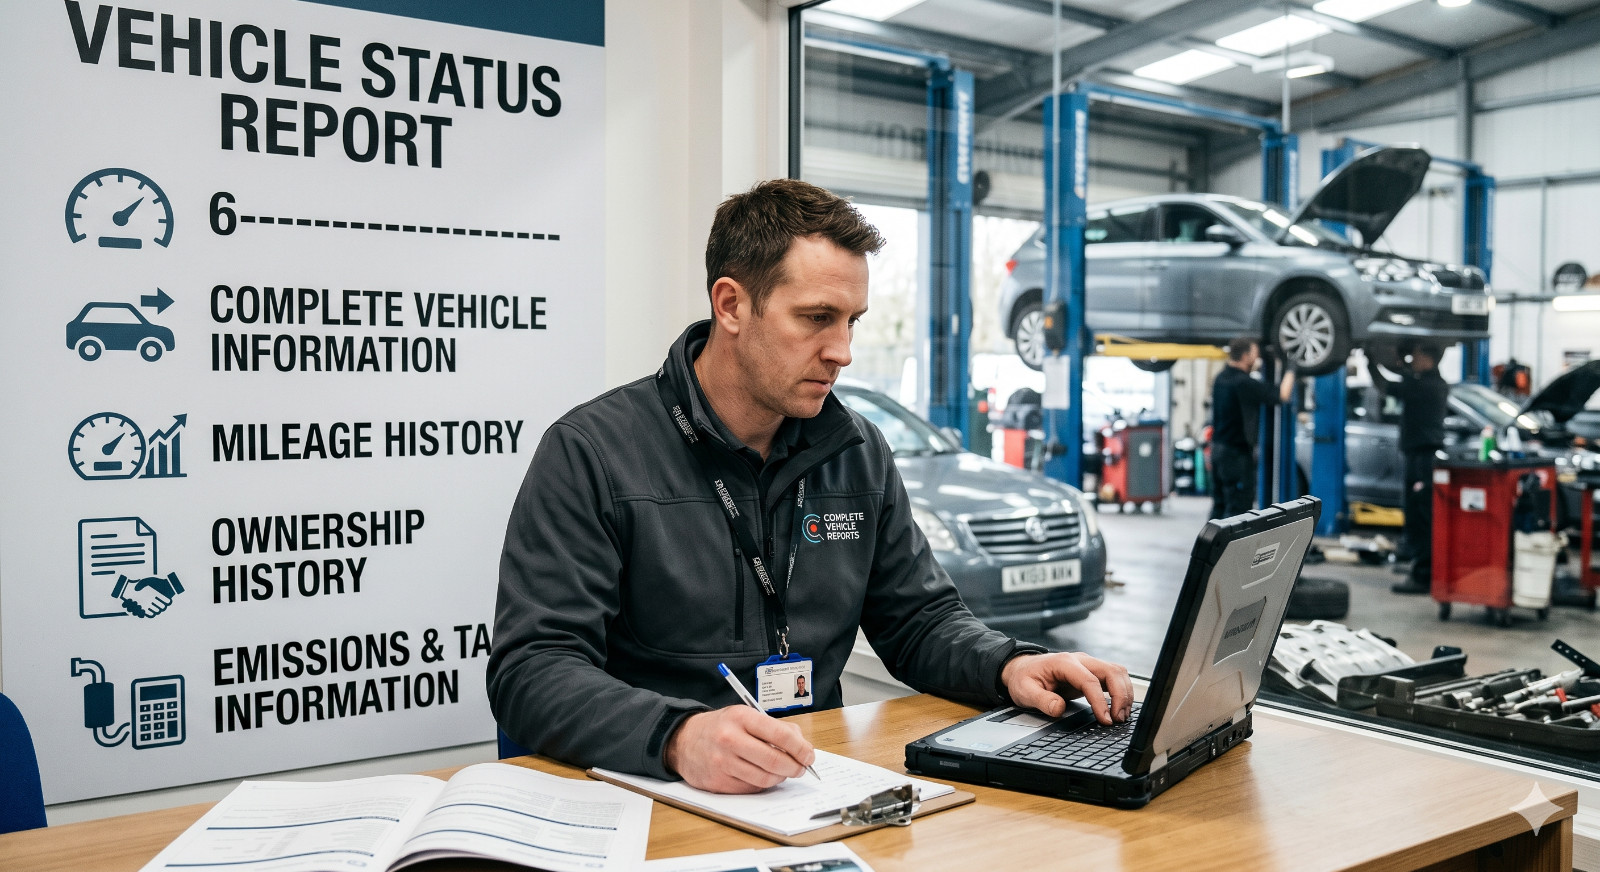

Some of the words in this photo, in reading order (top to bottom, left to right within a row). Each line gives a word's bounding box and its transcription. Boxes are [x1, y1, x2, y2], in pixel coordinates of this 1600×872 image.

[64, 0, 342, 93] VEHICLE
[361, 42, 562, 118] STATUS
[220, 92, 453, 169] REPORT
[210, 284, 404, 327] COMPLETE
[413, 292, 547, 330] VEHICLE
[211, 333, 457, 373] INFORMATION
[212, 421, 373, 462] MILEAGE
[385, 420, 524, 458] HISTORY
[211, 509, 425, 557] OWNERSHIP
[823, 512, 865, 522] COMPLETE
[825, 521, 857, 531] VEHICLE
[826, 531, 860, 541] REPORTS
[212, 556, 368, 605] HISTORY
[213, 630, 410, 687] EMISSIONS
[420, 628, 445, 664] &
[453, 623, 492, 660] TA
[214, 669, 459, 734] INFORMATION
